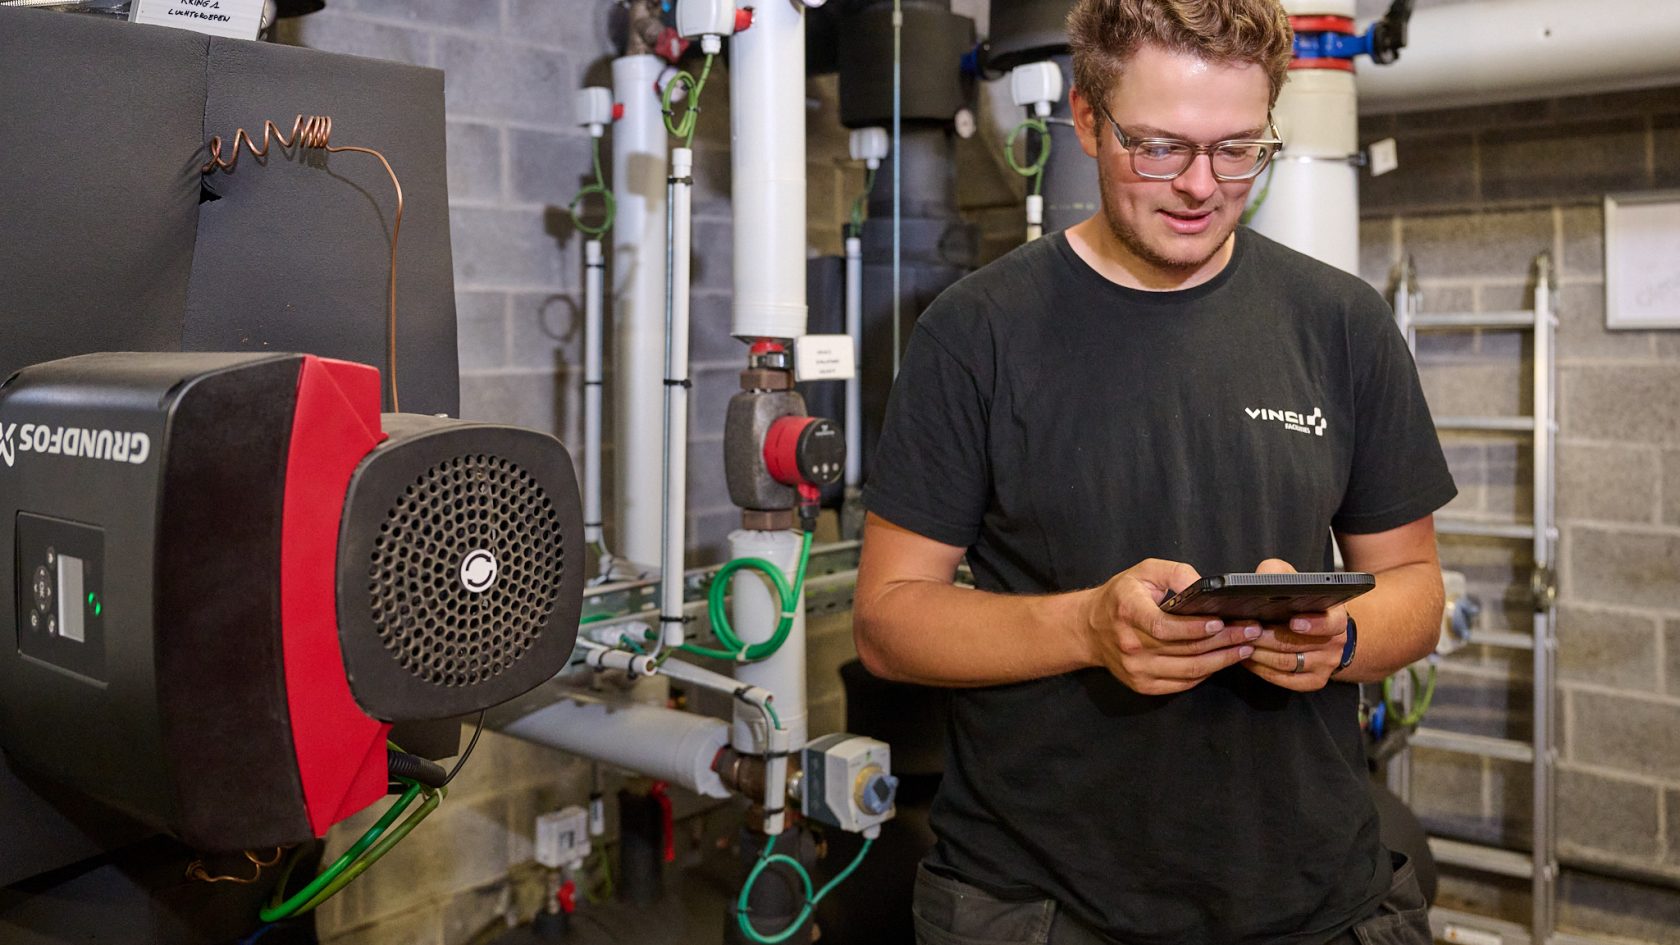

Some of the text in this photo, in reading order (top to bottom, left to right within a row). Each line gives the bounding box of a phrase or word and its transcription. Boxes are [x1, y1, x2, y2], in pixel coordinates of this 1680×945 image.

[209, 1, 220, 9] 1
[167, 8, 231, 22] LUCHTGROEPEN
[1244, 407, 1305, 426] VINCI
[18, 423, 150, 464] GRUNDFOS
